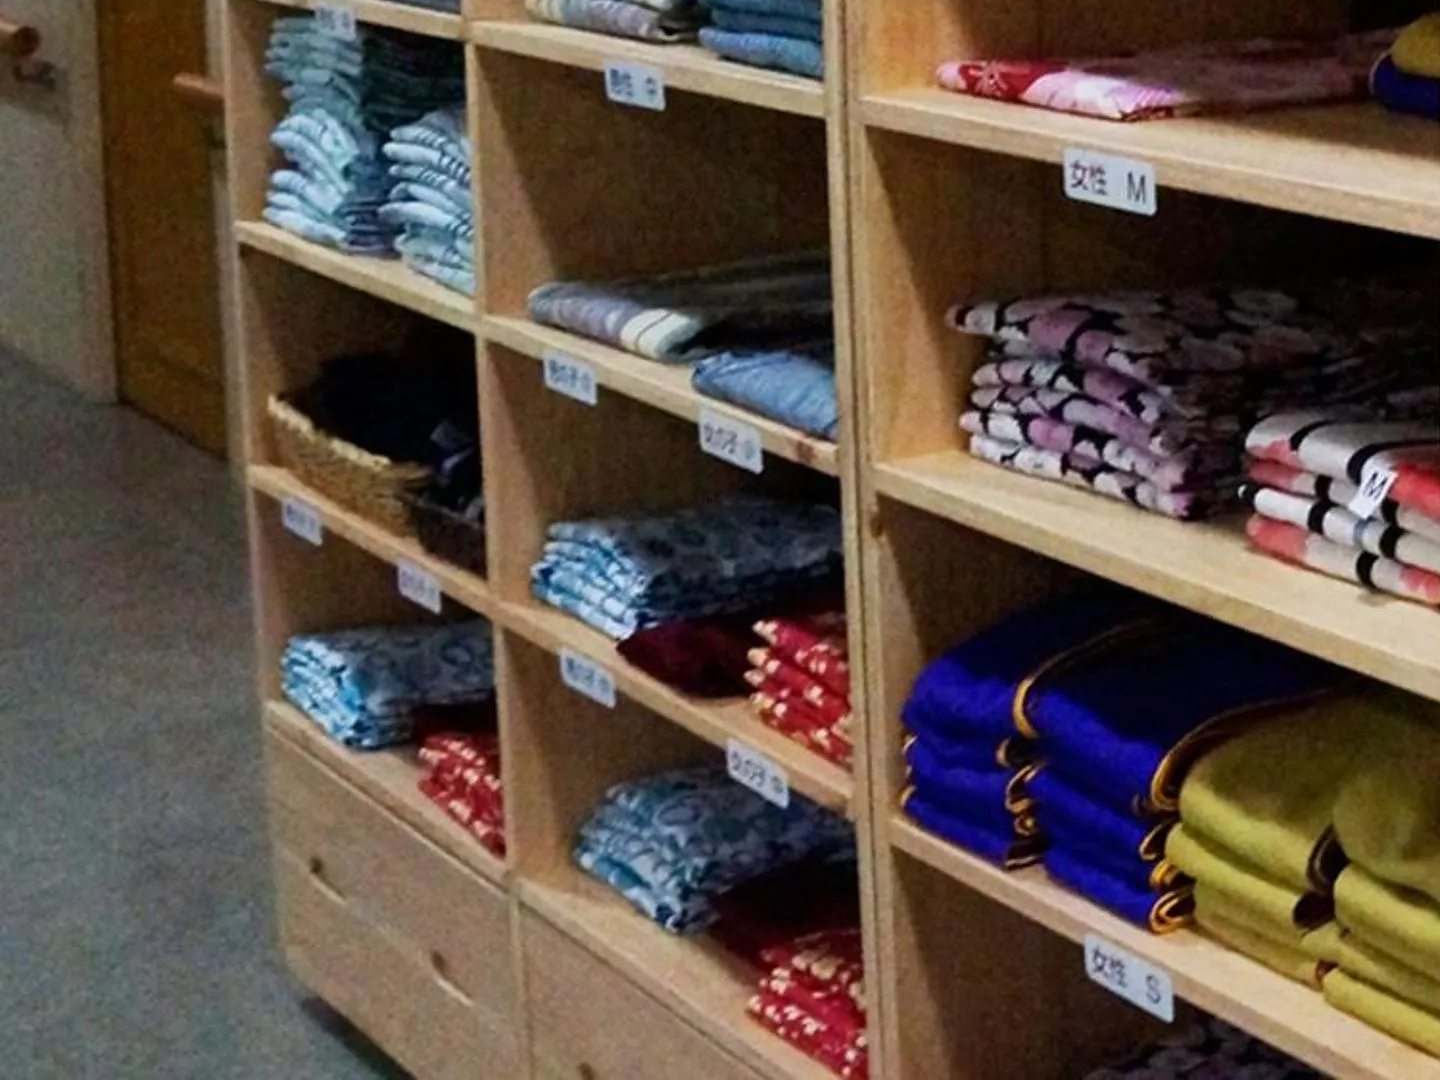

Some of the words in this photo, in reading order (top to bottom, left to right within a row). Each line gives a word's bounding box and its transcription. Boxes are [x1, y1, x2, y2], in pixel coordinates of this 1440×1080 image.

[1070, 160, 1107, 196] 女性
[1126, 171, 1146, 204] M
[1090, 948, 1128, 989] 女性
[1145, 974, 1162, 1005] S
